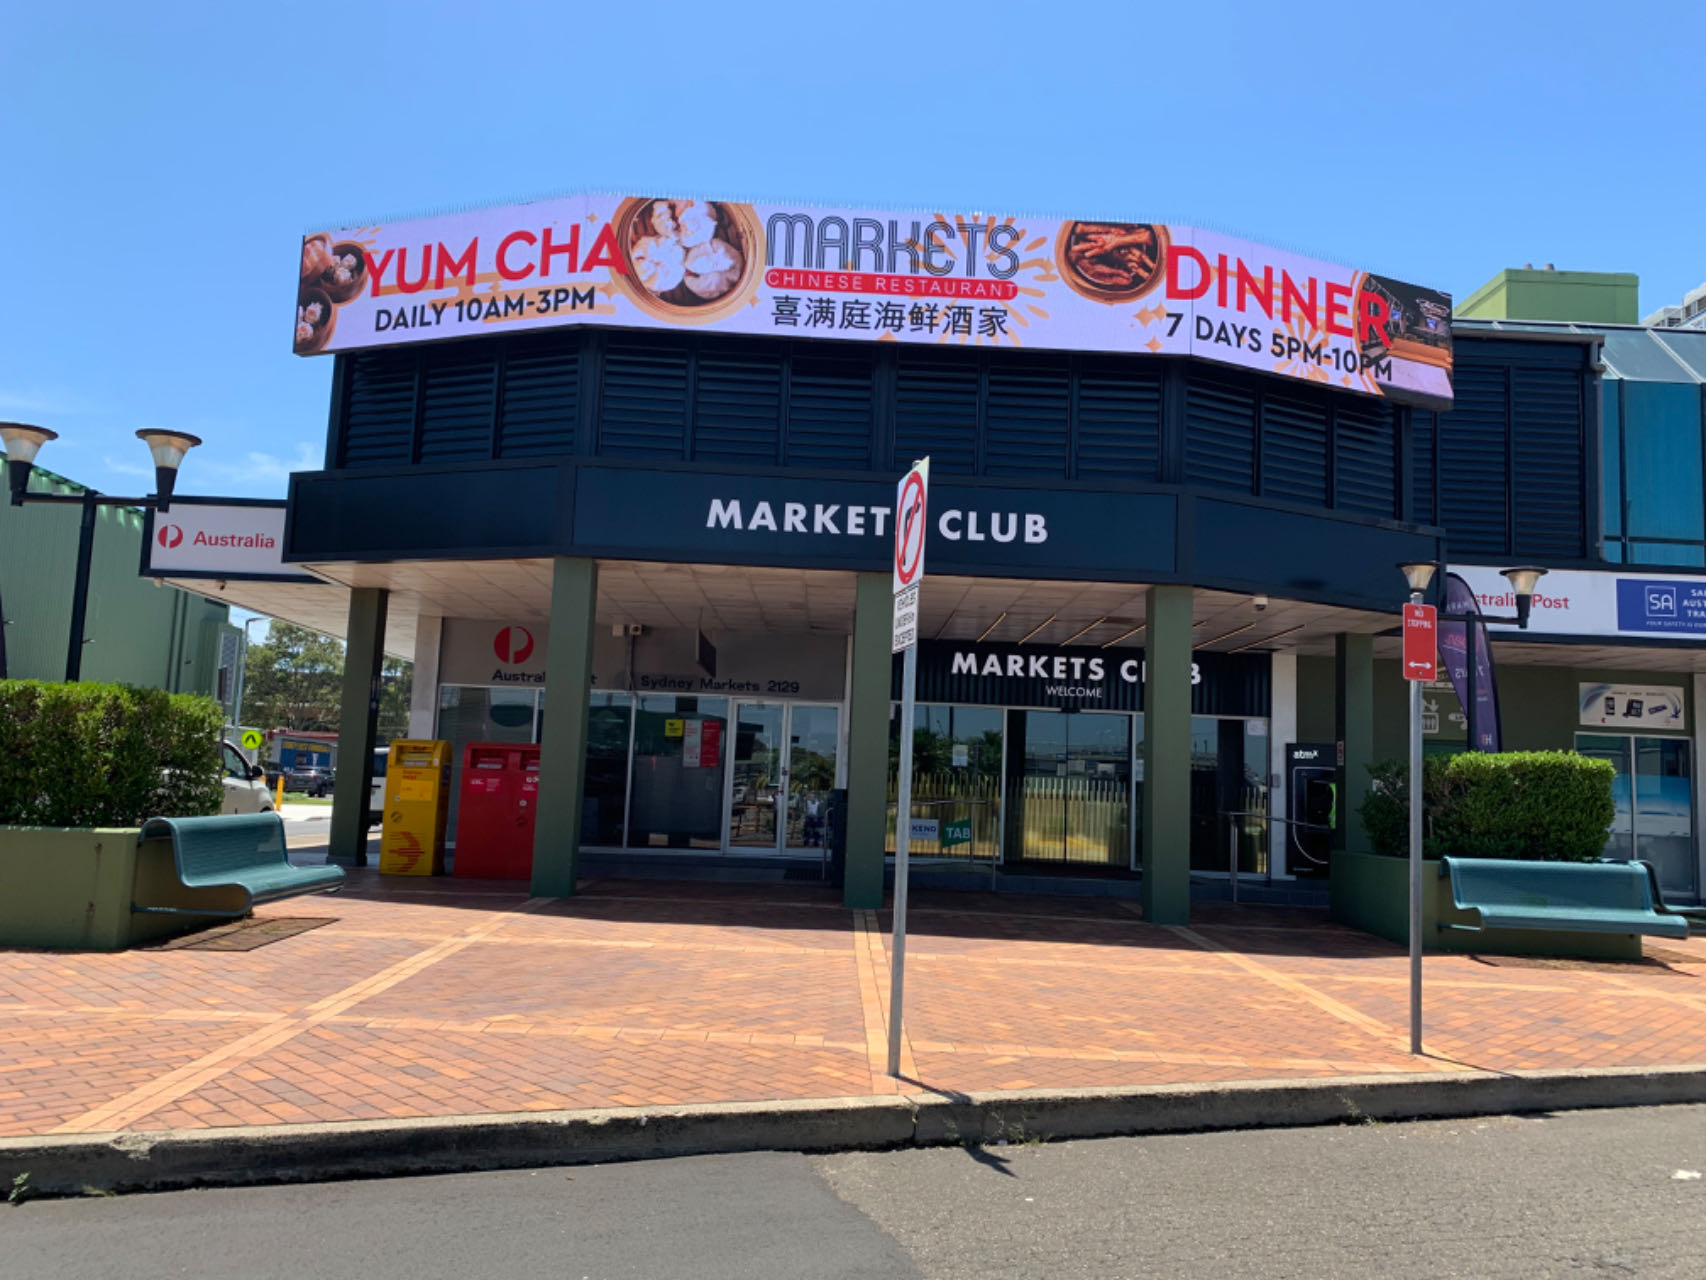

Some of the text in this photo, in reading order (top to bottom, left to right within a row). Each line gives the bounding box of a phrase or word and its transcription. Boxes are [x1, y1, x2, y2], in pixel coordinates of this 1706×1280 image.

[363, 223, 630, 297] YUM CHA
[766, 213, 1019, 280] MARKETS
[767, 271, 1016, 298] CHINESE RESTAURANT
[1166, 245, 1393, 347] DINNER
[375, 286, 595, 332] DAILY 10AM-3PM
[772, 296, 1008, 337] 喜满庭海鲜酒家
[1166, 313, 1393, 381] 7 DAYS 5PM-10PM
[706, 499, 1048, 544] MARKET CLUB
[193, 530, 275, 548] Australia
[1531, 594, 1569, 609] Post
[1650, 594, 1673, 610] SA
[492, 669, 546, 683] Austral
[951, 652, 1105, 681] MARKETS
[641, 675, 800, 693] Sydney Markets 2129
[1045, 685, 1103, 698] WELCOME
[946, 827, 970, 839] TAB
